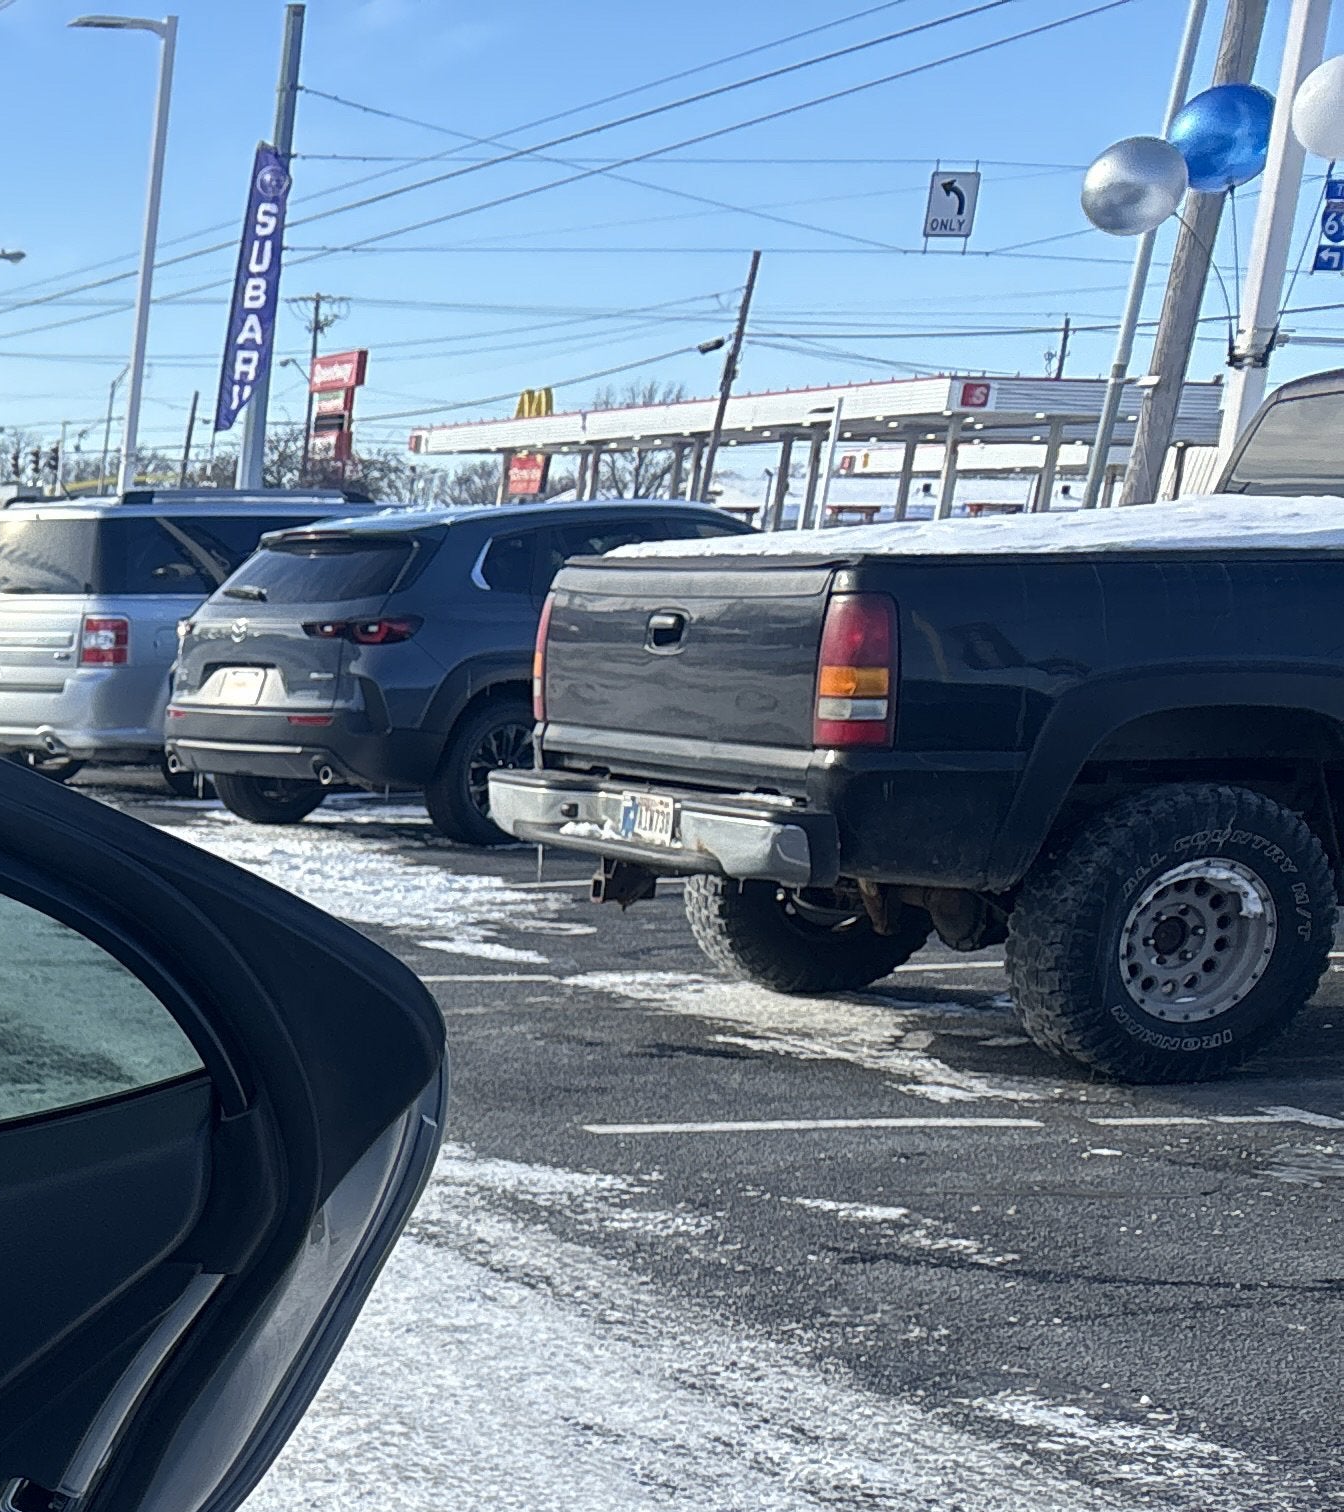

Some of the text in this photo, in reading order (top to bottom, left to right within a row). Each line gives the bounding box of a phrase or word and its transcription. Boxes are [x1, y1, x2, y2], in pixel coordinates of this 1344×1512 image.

[931, 218, 966, 231] ONLY
[1123, 853, 1167, 900] ALL
[1174, 829, 1298, 873] COUNTRY
[1110, 1004, 1233, 1050] IRONMAN
